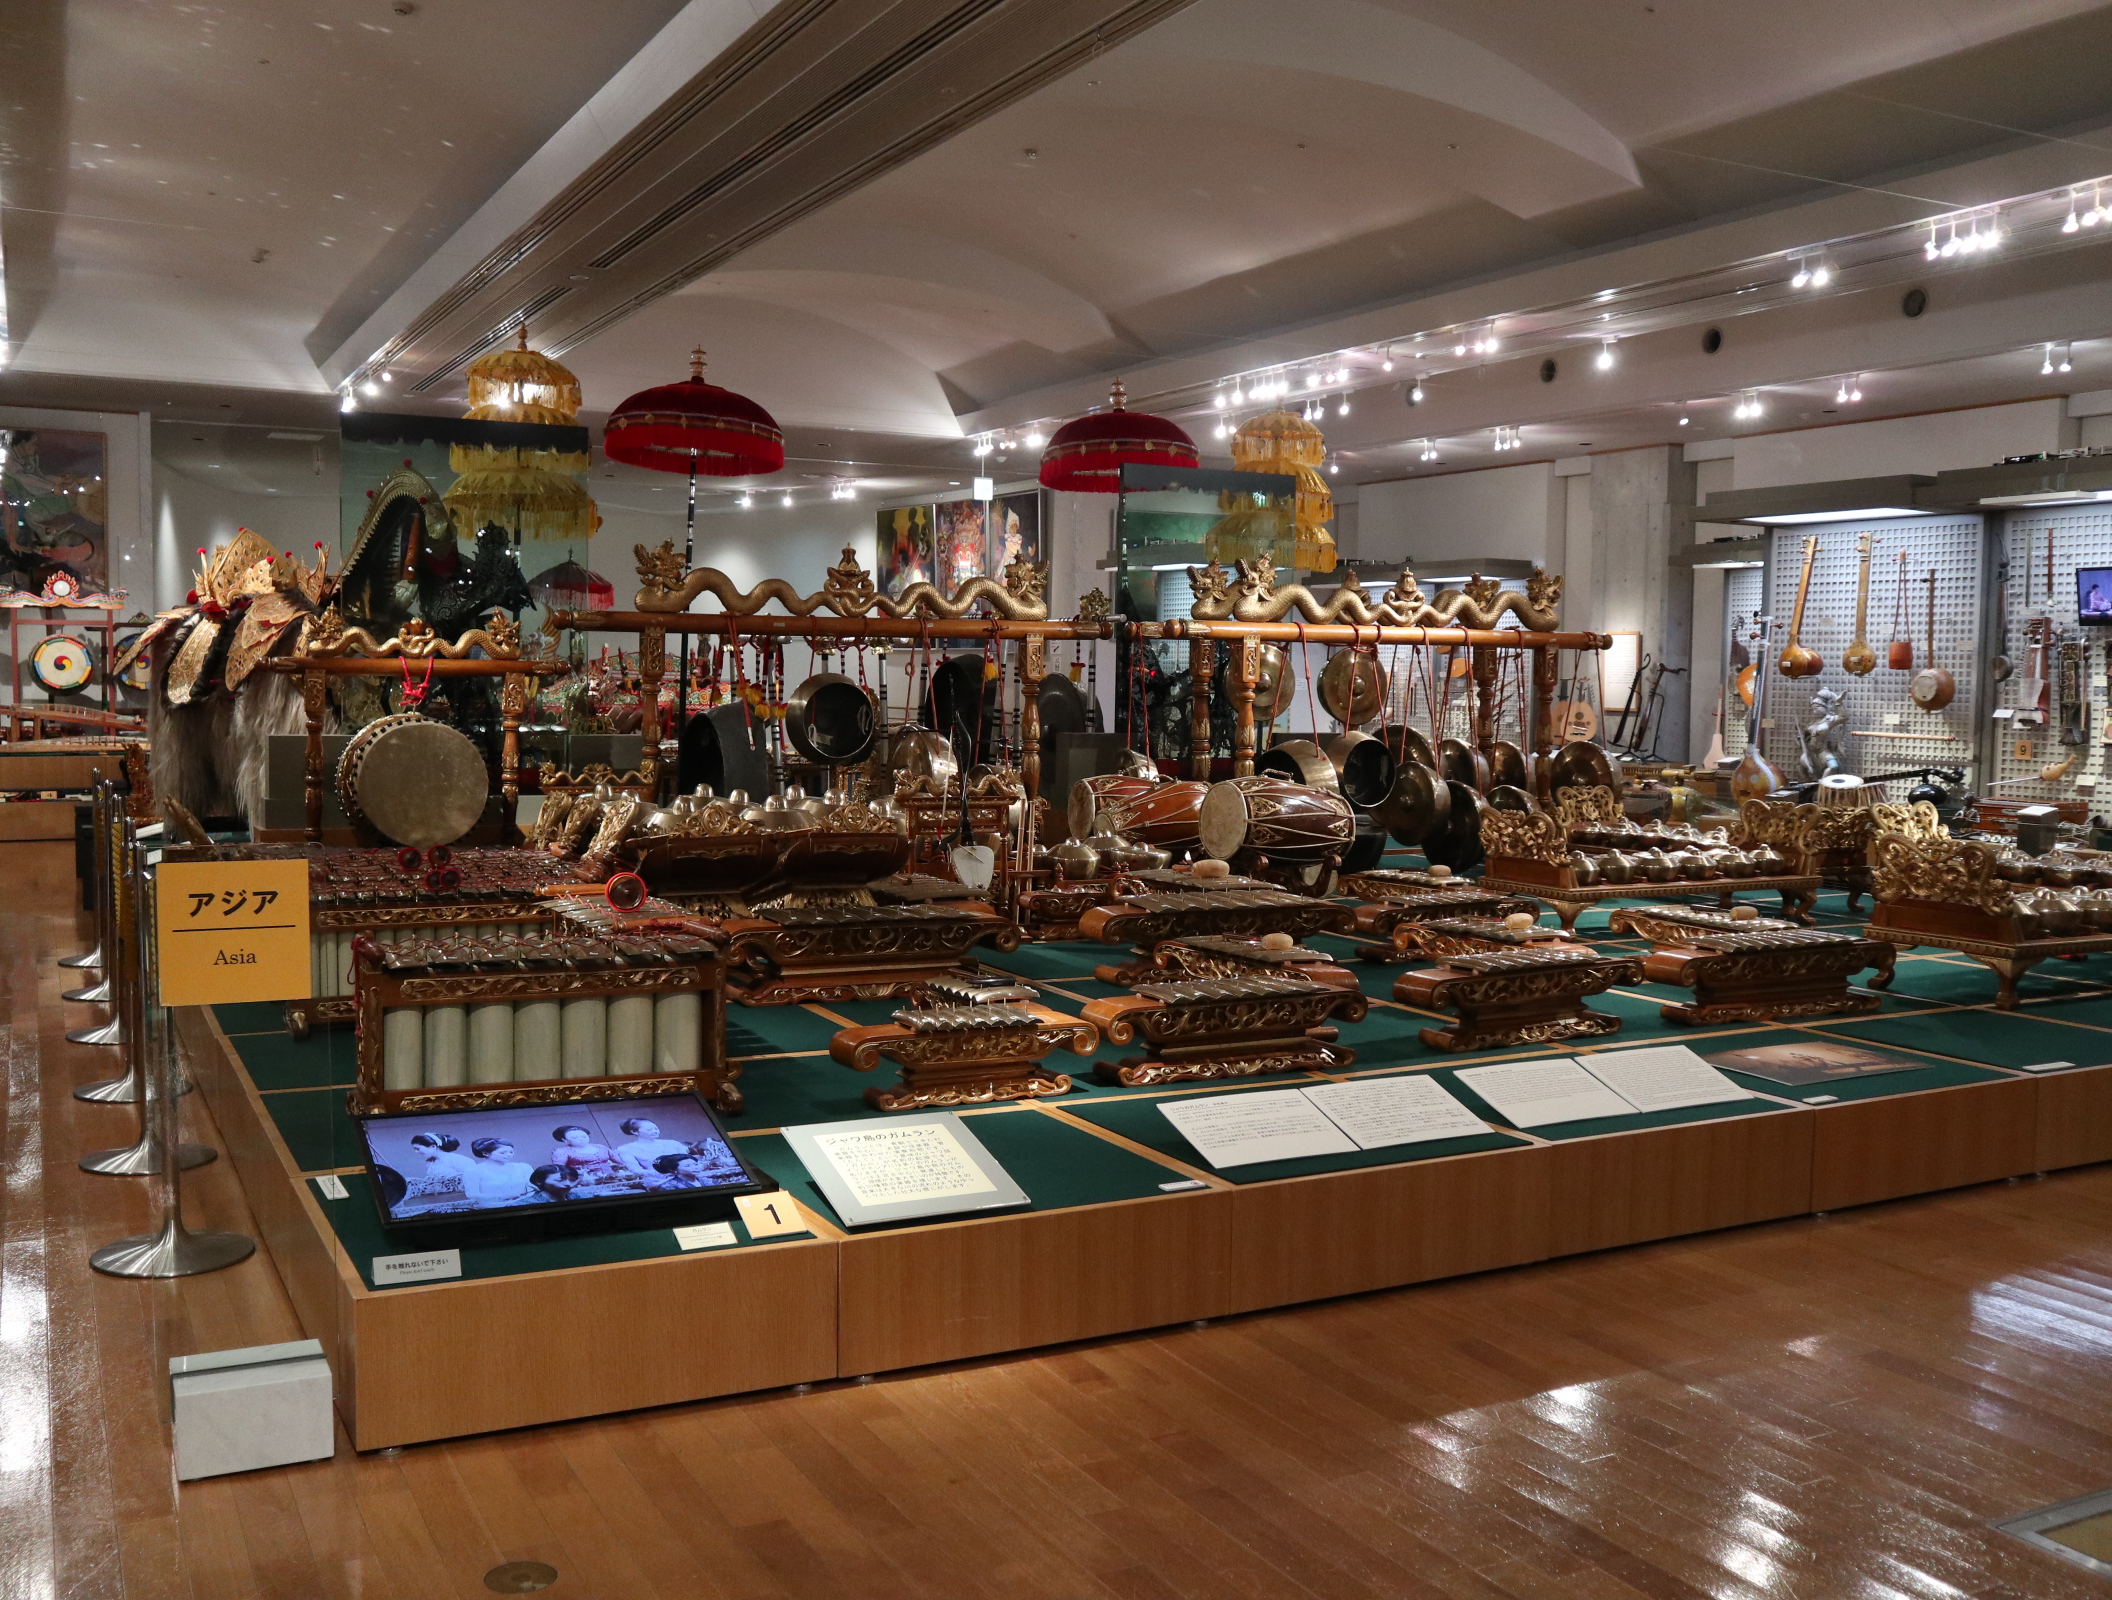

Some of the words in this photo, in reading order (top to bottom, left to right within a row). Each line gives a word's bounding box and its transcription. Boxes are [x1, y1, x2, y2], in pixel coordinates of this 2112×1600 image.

[2020, 745, 2027, 755] 9
[188, 889, 279, 917] アジア
[213, 949, 257, 966] Asia
[826, 1129, 935, 1145] ジャワ島のガムラン
[764, 1204, 781, 1224] 1
[385, 1259, 448, 1270] 手を触れないで下さい
